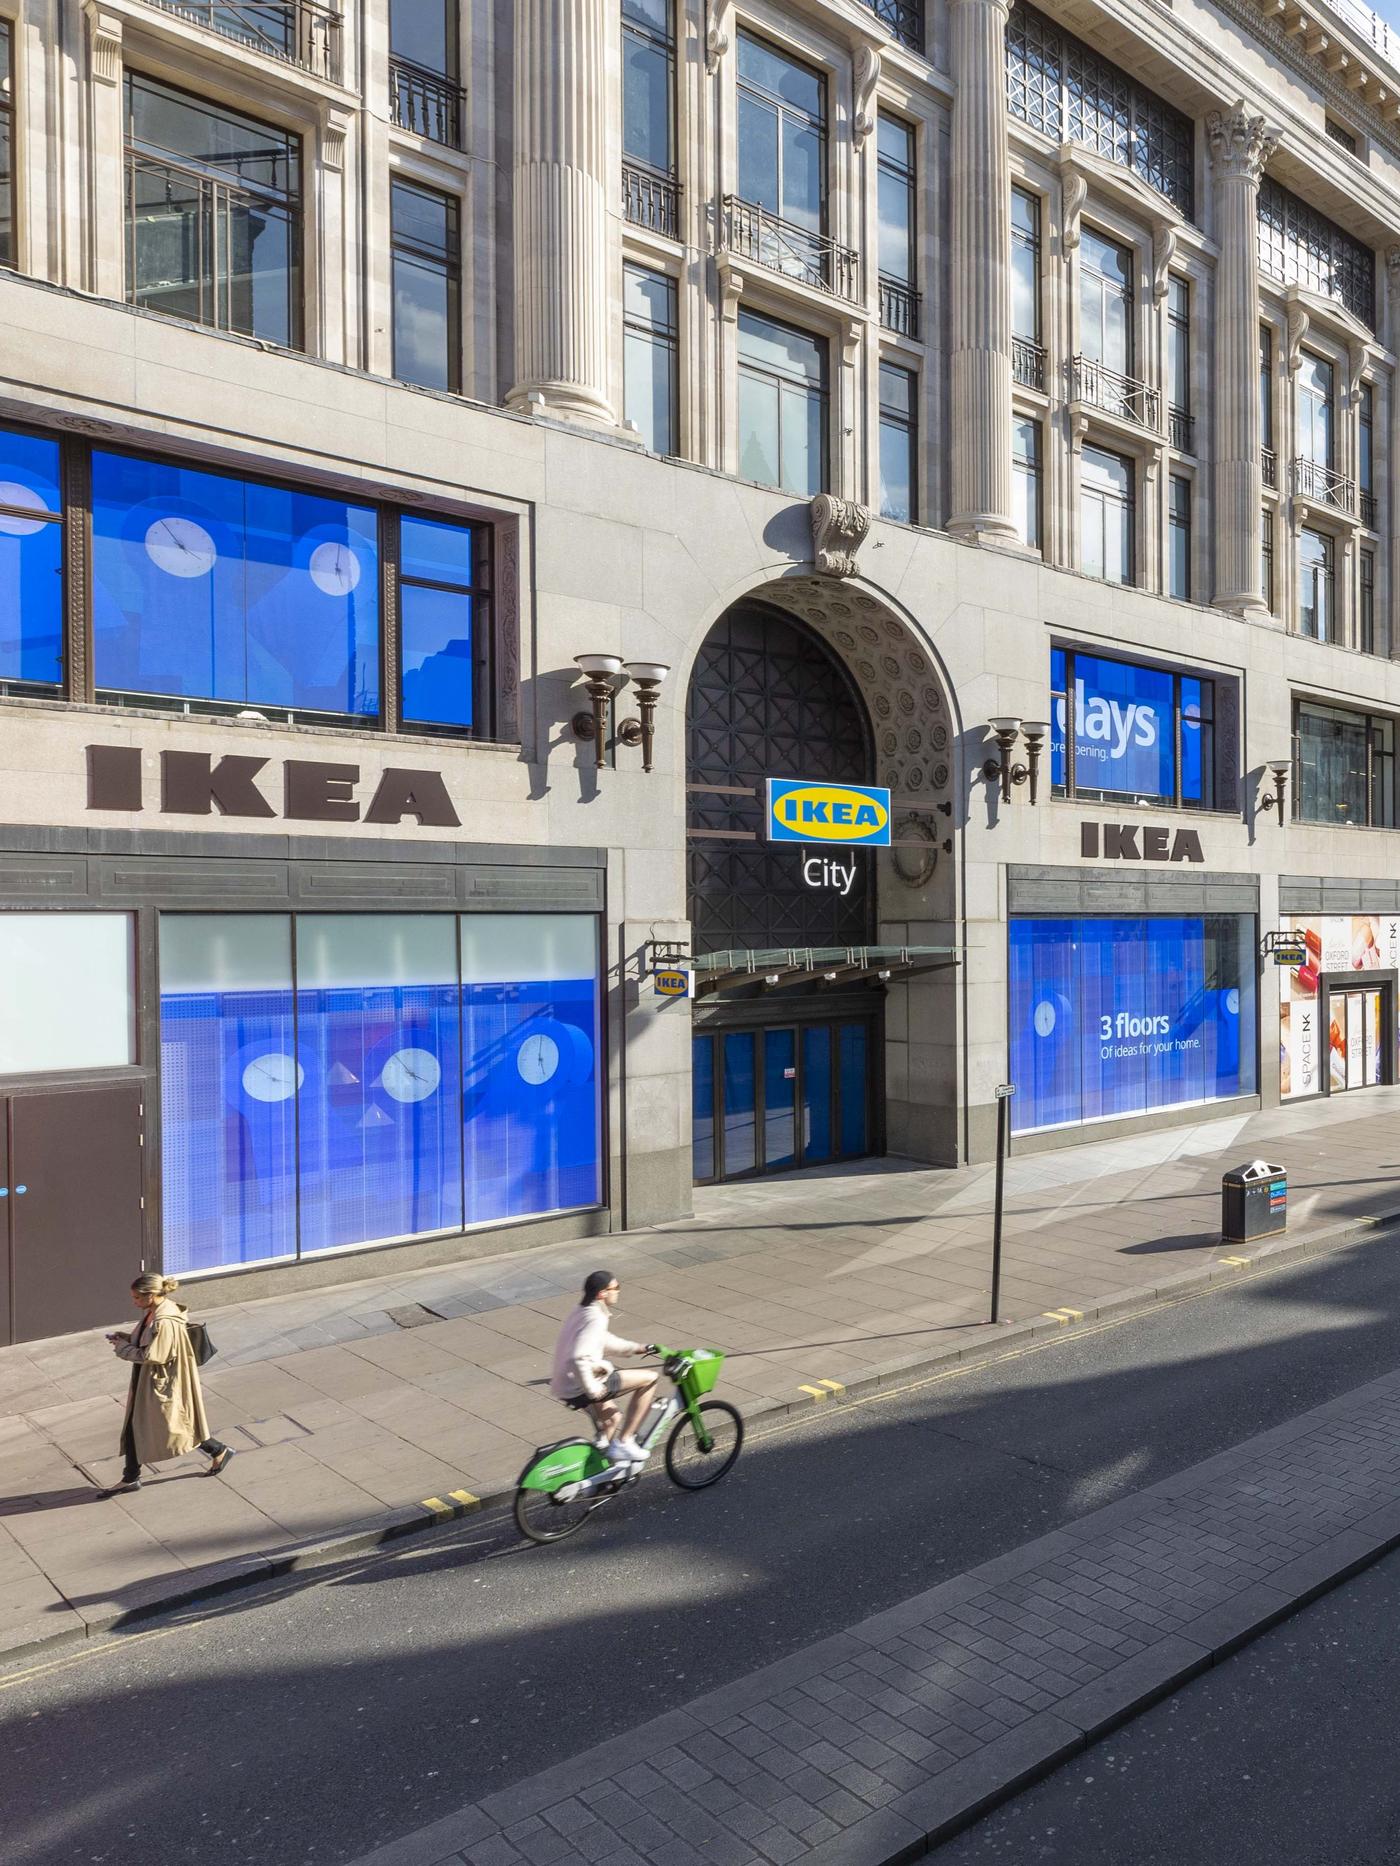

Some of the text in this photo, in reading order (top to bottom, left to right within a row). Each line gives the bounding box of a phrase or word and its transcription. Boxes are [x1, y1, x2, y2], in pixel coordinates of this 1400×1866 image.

[1056, 678, 1155, 759] days
[86, 744, 462, 827] IKEA
[785, 799, 880, 826] IKEA
[1081, 821, 1205, 863] IKEA
[803, 858, 857, 895] City
[657, 977, 685, 988] IKEA
[1100, 1012, 1169, 1040] 3 floors
[1101, 1038, 1201, 1059] Of ideas for your home.
